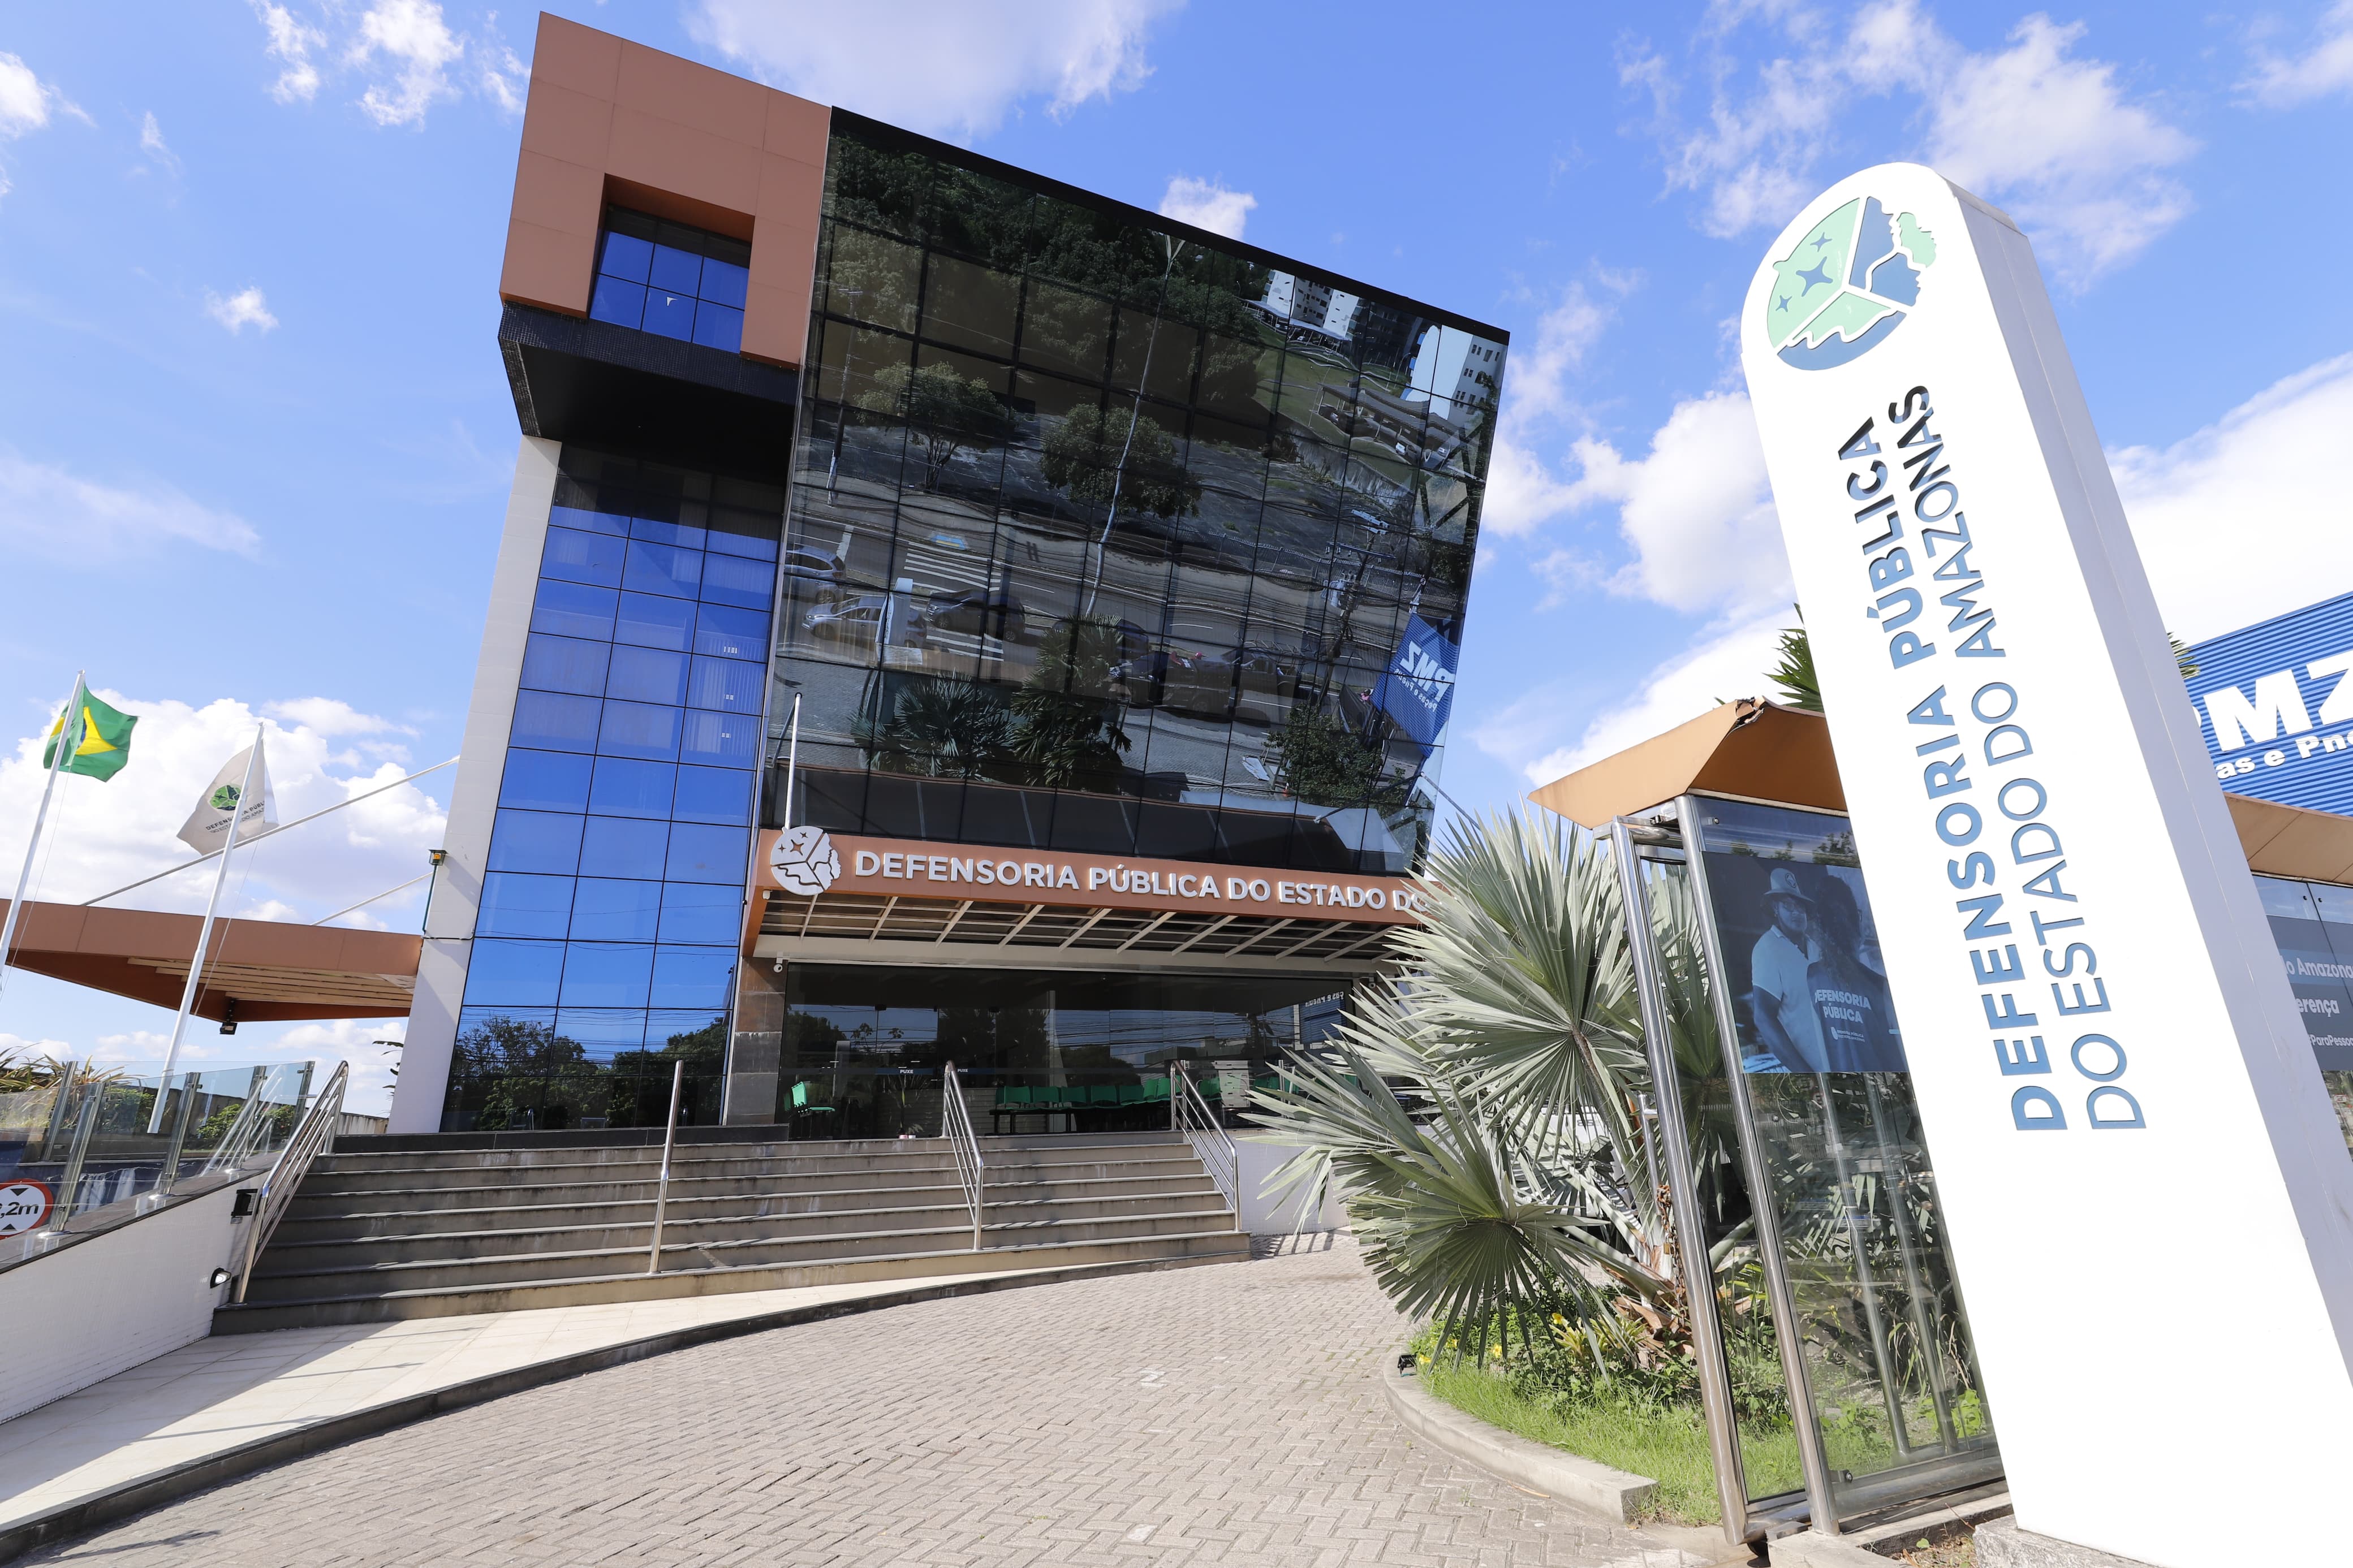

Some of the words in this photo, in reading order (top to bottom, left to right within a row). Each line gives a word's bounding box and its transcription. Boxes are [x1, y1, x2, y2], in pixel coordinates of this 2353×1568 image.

[1838, 416, 1938, 669] PÚBLICA
[1888, 385, 2006, 658] AMAZONAS
[1971, 681, 2034, 766] DO
[2192, 650, 2353, 751] MZ
[2264, 750, 2286, 767] e
[855, 850, 1080, 890] DEFENSORIA
[1089, 863, 1221, 899] PÚBLICA
[1228, 878, 1271, 902] DO
[1279, 881, 1386, 909] ESTADO
[1907, 684, 2068, 1130] DEFENSORIA
[1997, 777, 2111, 1016] ESTADO
[1822, 1003, 1864, 1024] PÚBLICA
[2070, 1033, 2147, 1130] DO
